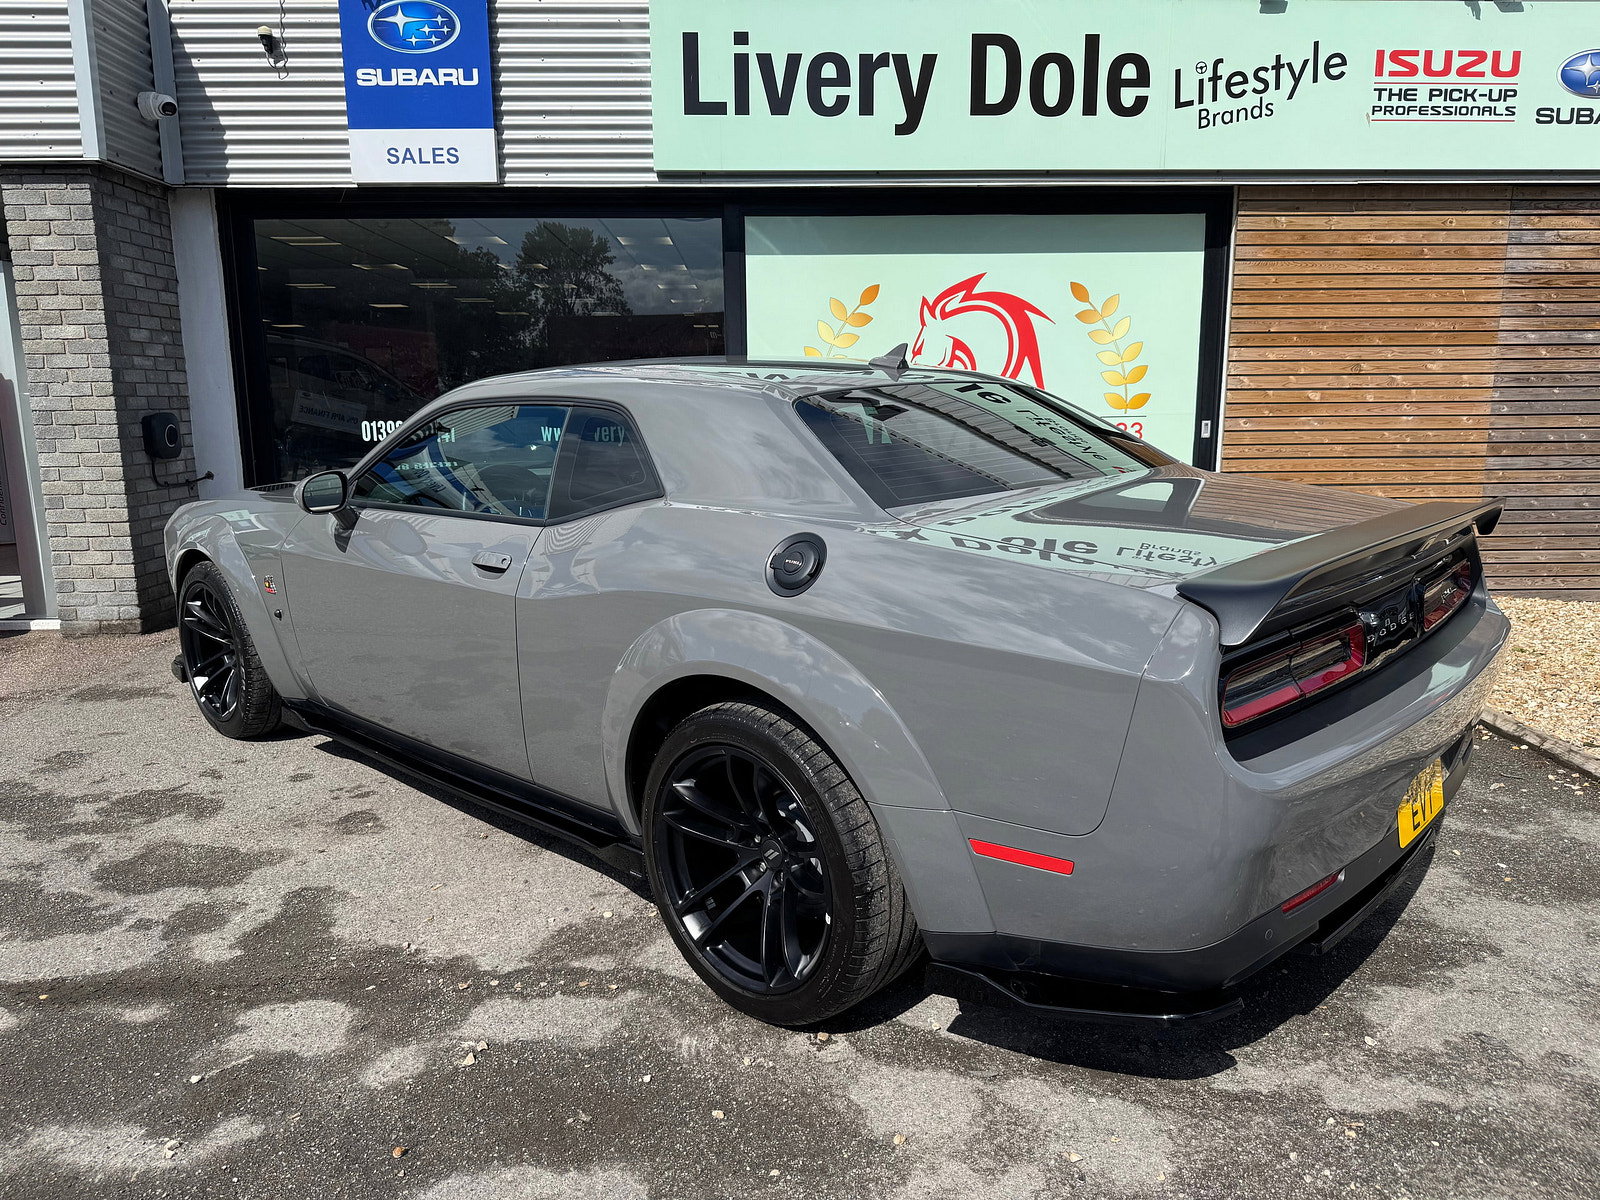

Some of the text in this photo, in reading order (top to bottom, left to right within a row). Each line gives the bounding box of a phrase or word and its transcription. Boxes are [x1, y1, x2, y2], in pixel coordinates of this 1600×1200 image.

[1174, 40, 1348, 110] Lifestyle
[1374, 49, 1522, 78] ISUZU
[356, 68, 479, 87] SUBARU
[682, 31, 1151, 136] Livery Dole
[1373, 88, 1518, 103] THE PICK-UP
[1198, 96, 1274, 130] Brands
[1371, 105, 1517, 117] PROFESSIONALS
[386, 147, 460, 165] SALES
[361, 420, 404, 441] 0139
[1366, 611, 1415, 643] DODGE
